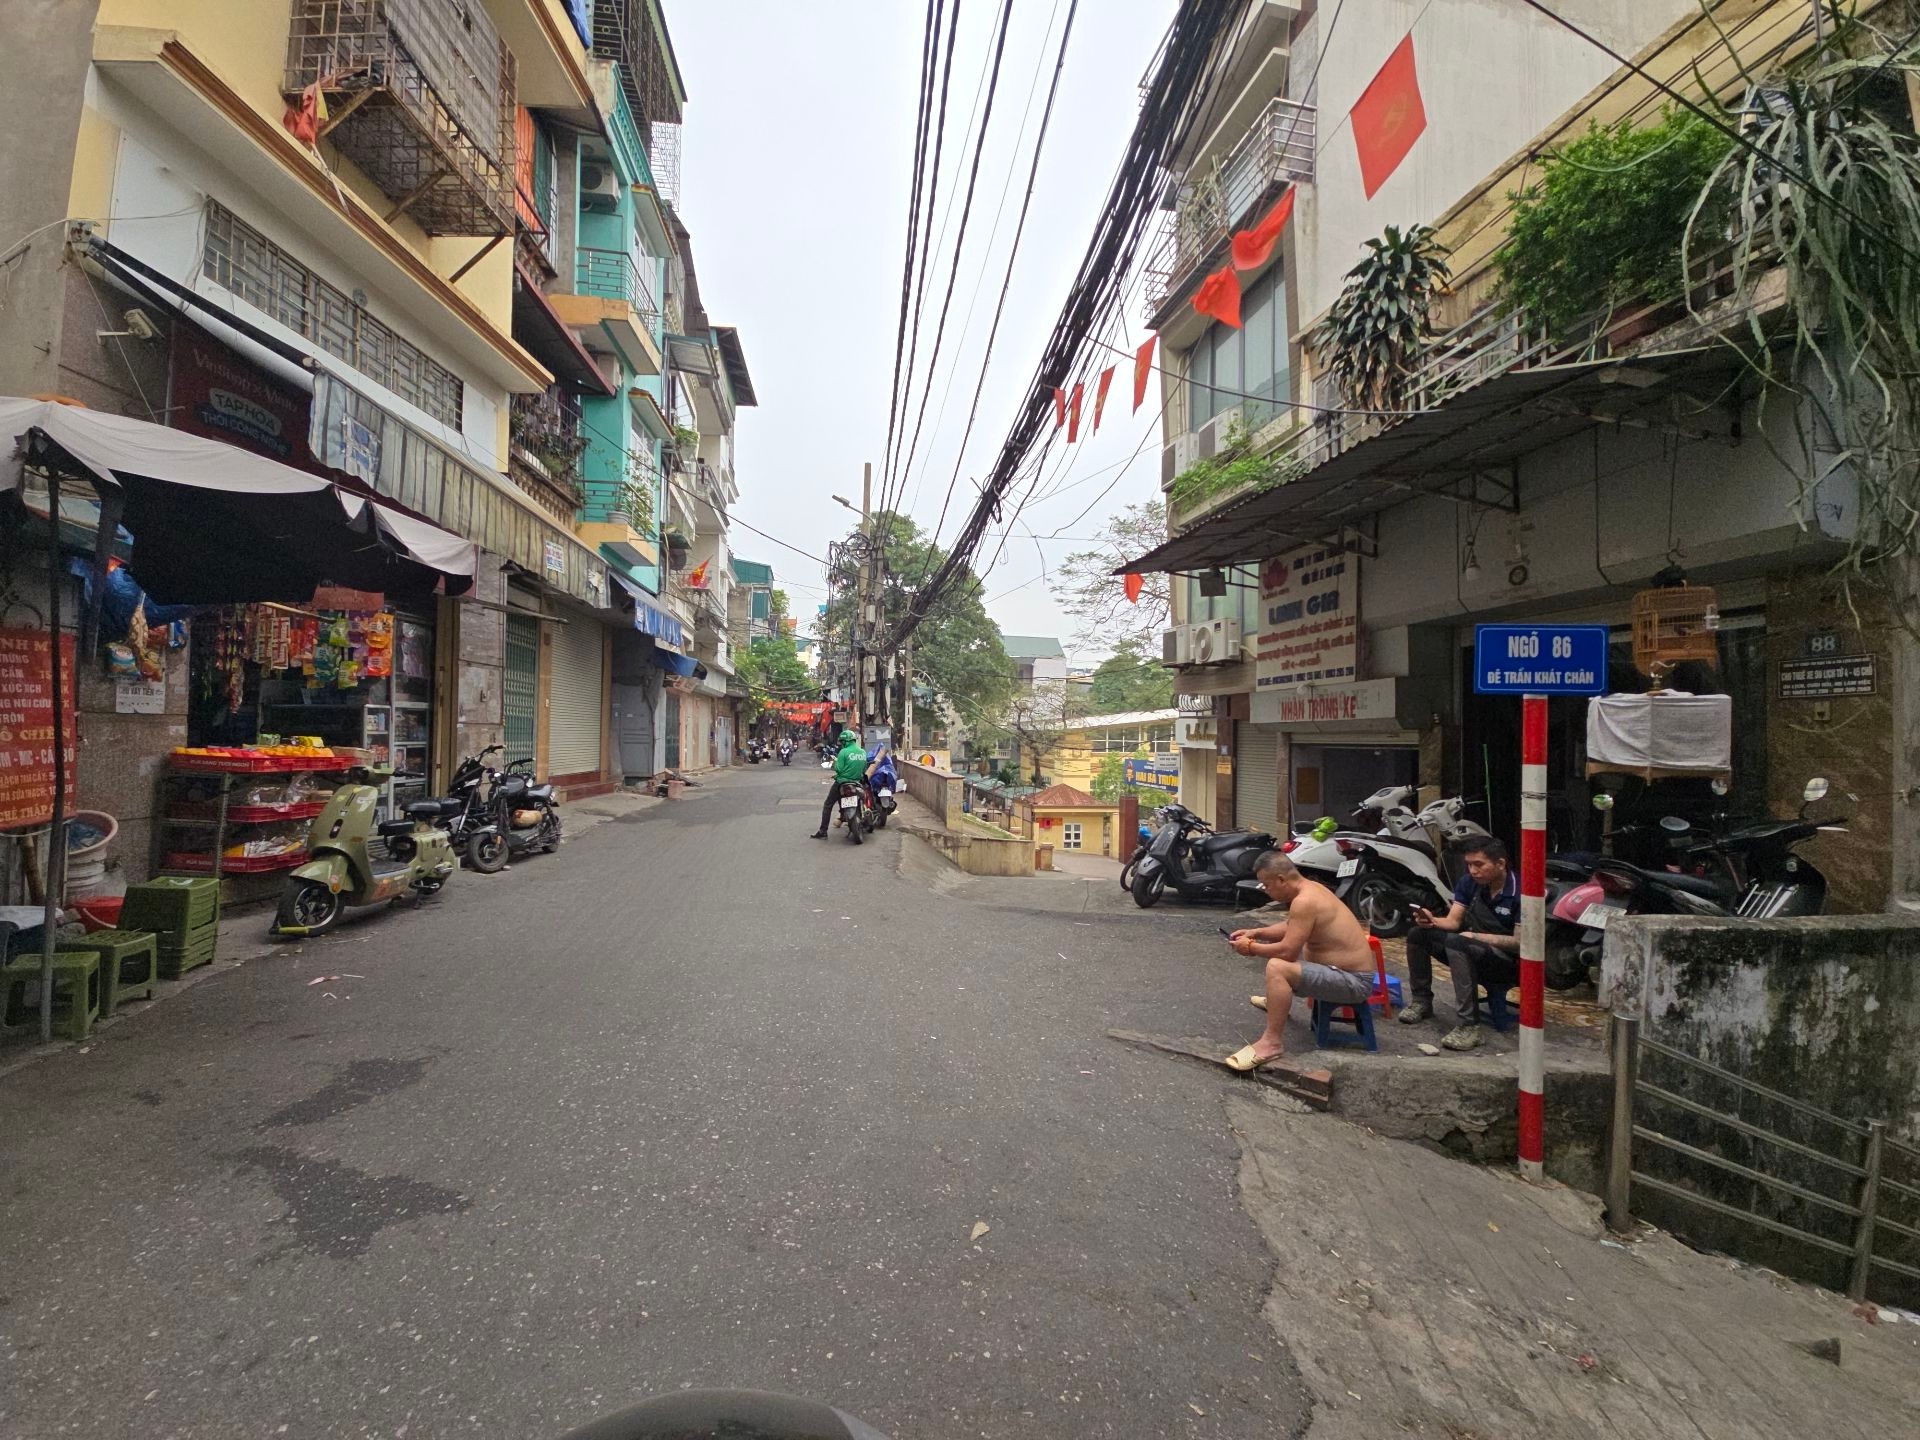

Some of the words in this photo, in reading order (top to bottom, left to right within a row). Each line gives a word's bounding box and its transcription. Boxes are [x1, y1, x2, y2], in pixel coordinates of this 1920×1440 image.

[1508, 631, 1539, 658] NGÕ
[1552, 636, 1572, 658] 86
[1811, 636, 1835, 652] 88
[1535, 668, 1562, 684] KHÁT
[1564, 668, 1595, 684] CHÂN
[1343, 695, 1357, 718] XE
